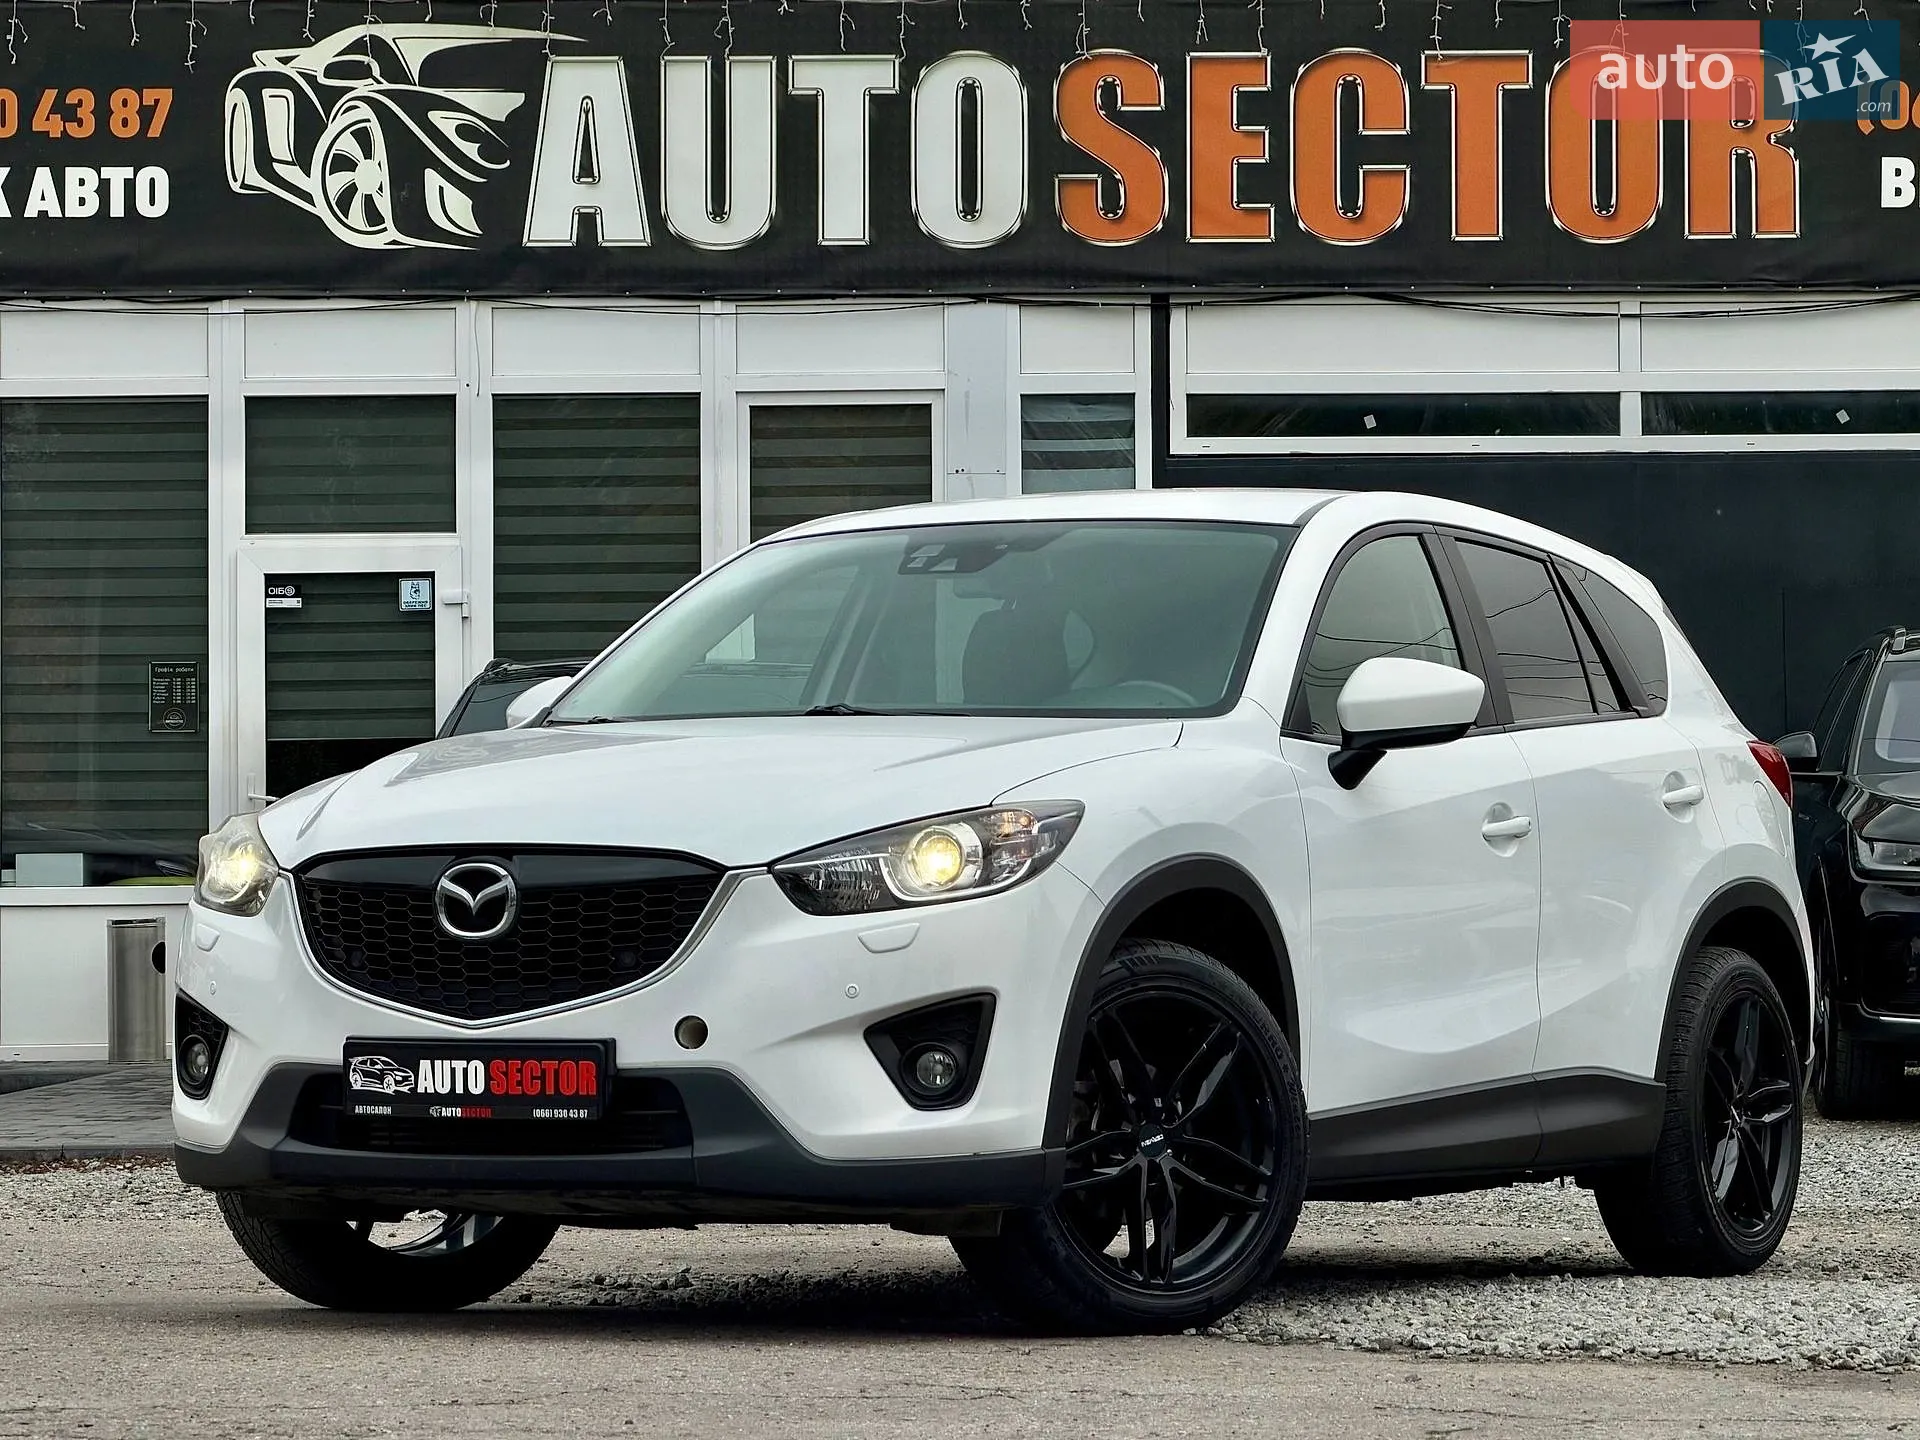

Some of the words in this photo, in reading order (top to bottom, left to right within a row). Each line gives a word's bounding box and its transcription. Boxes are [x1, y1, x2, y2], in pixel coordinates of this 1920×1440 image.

[32, 88, 96, 139] 43
[109, 88, 173, 139] 87
[23, 166, 170, 218] АВТО
[416, 1059, 485, 1096] AUTO
[489, 1060, 597, 1097] SECTOR
[553, 1109, 568, 1119] 930
[568, 1109, 578, 1119] 43
[579, 1109, 588, 1119] 87
